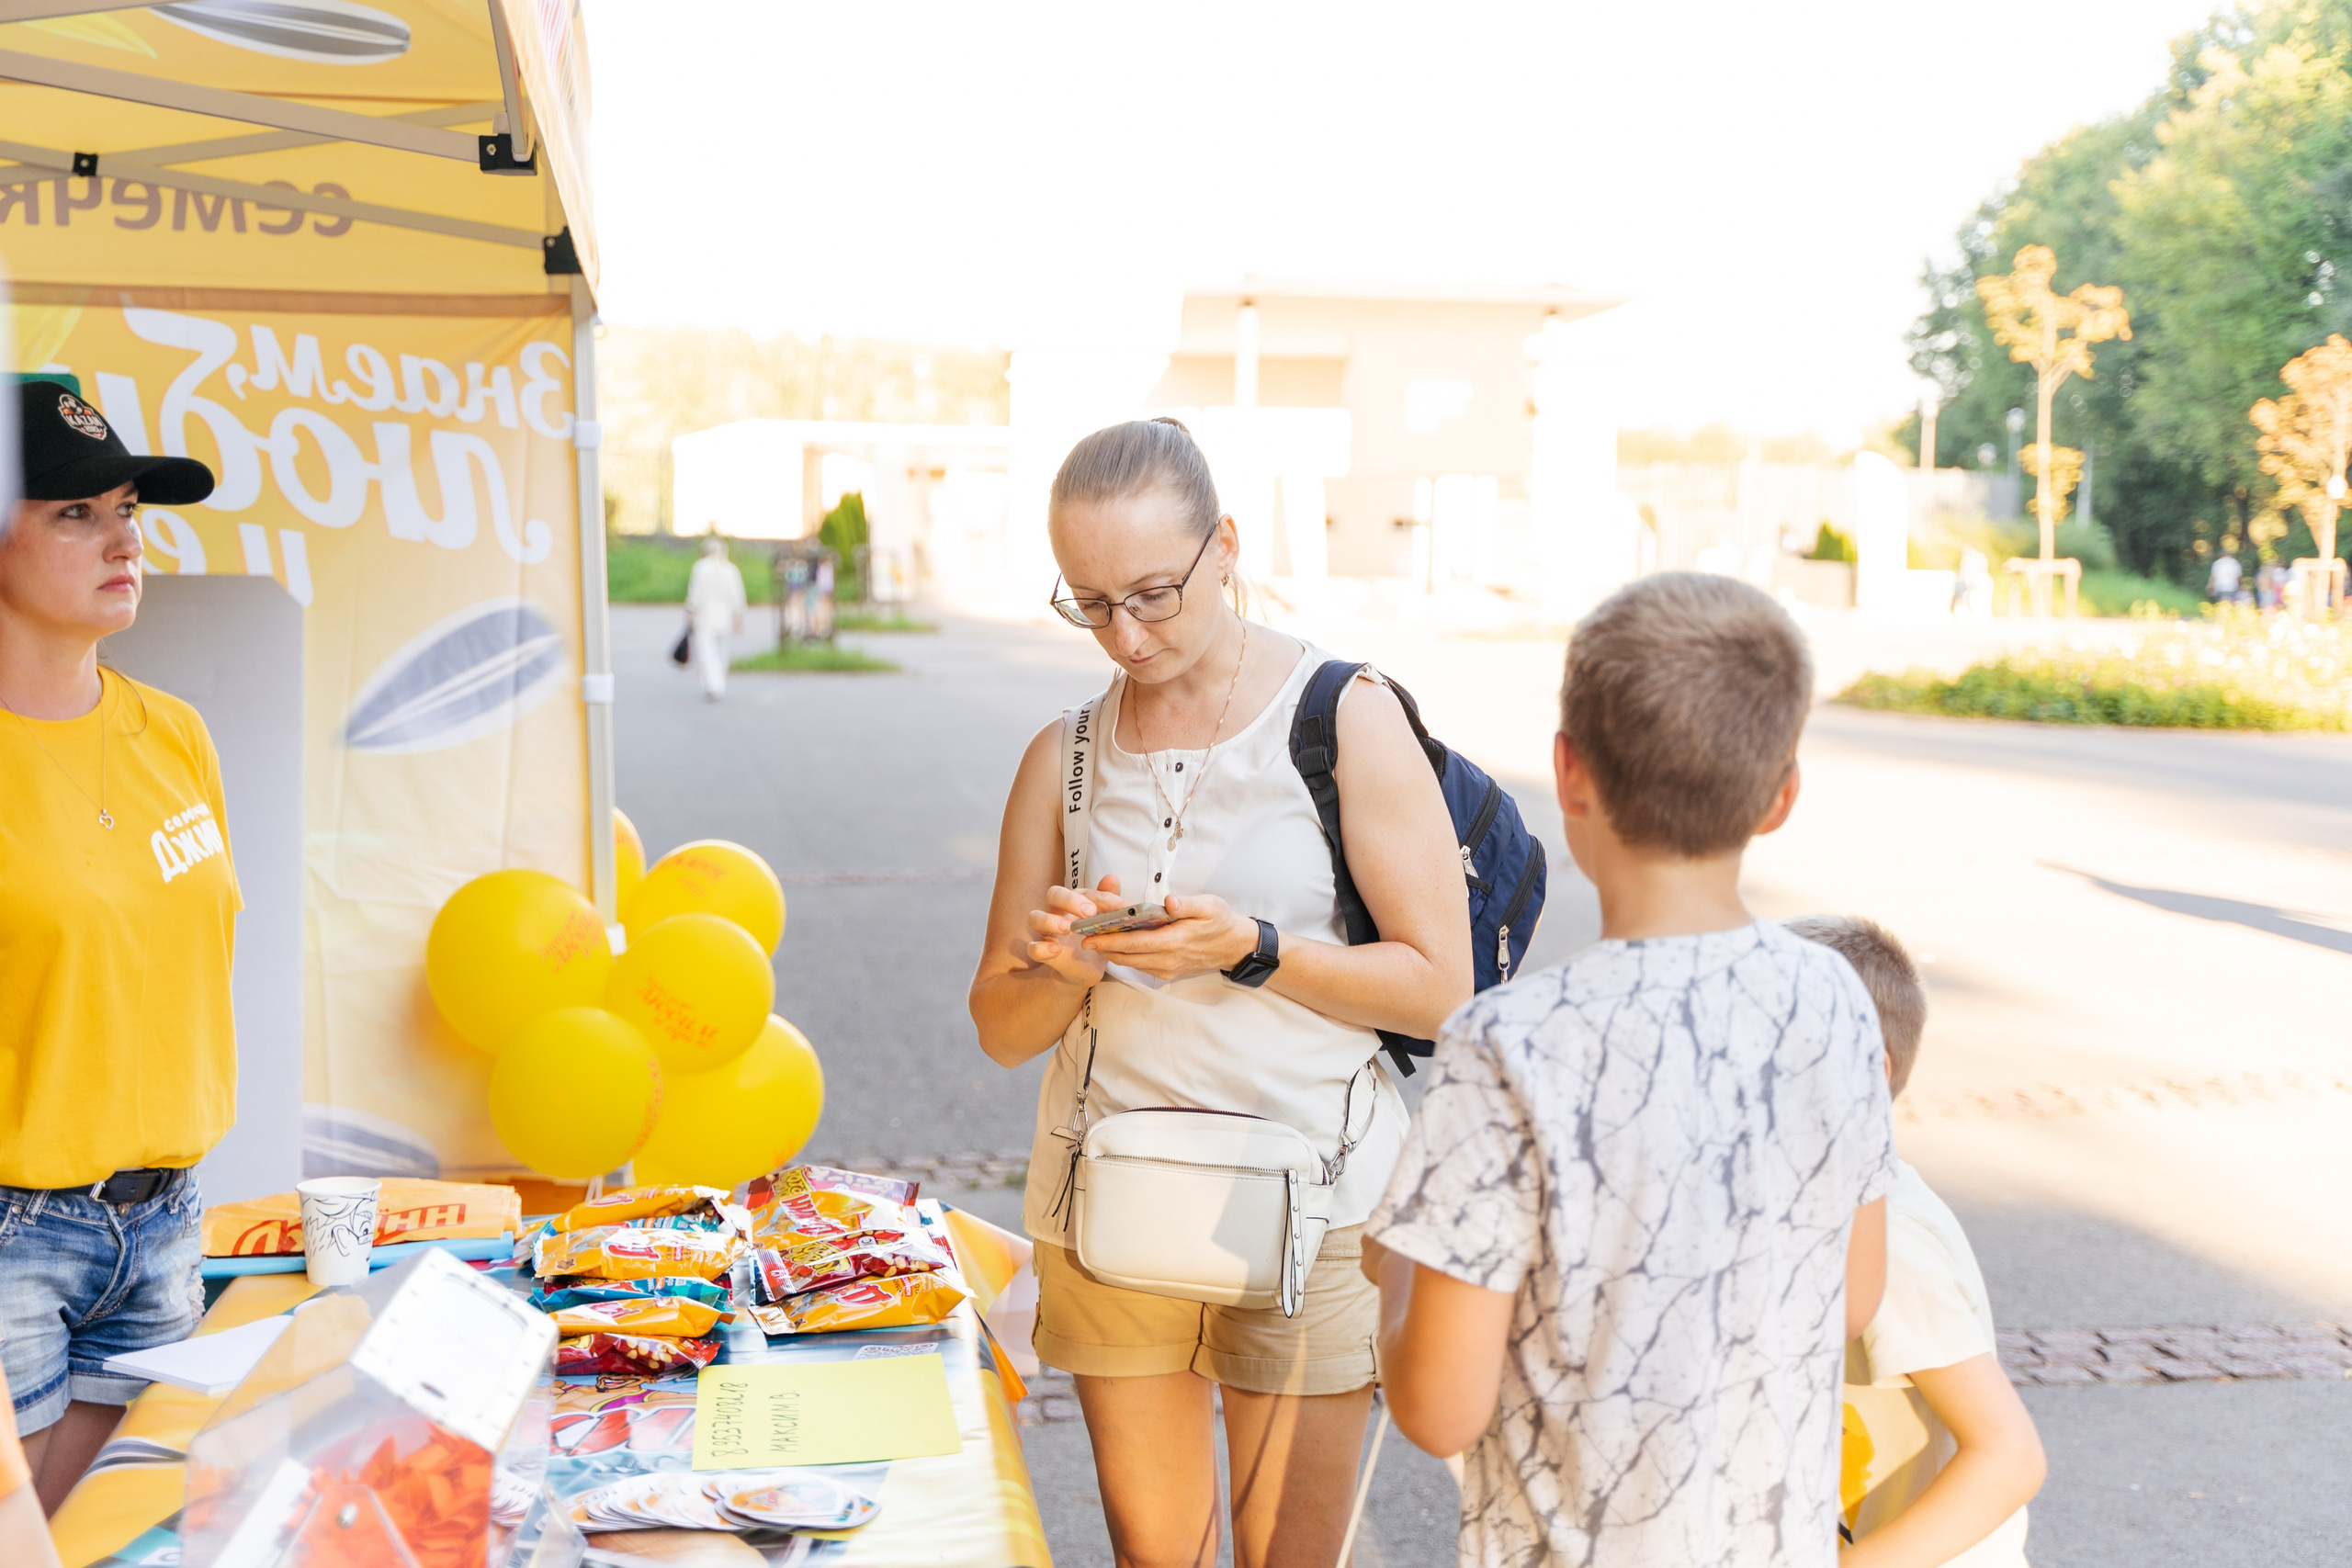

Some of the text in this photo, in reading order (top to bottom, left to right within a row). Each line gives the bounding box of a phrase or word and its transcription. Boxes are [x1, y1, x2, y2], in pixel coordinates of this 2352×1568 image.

[1069, 708, 1091, 814] Follow your
[769, 1402, 800, 1453] МАКСИМ
